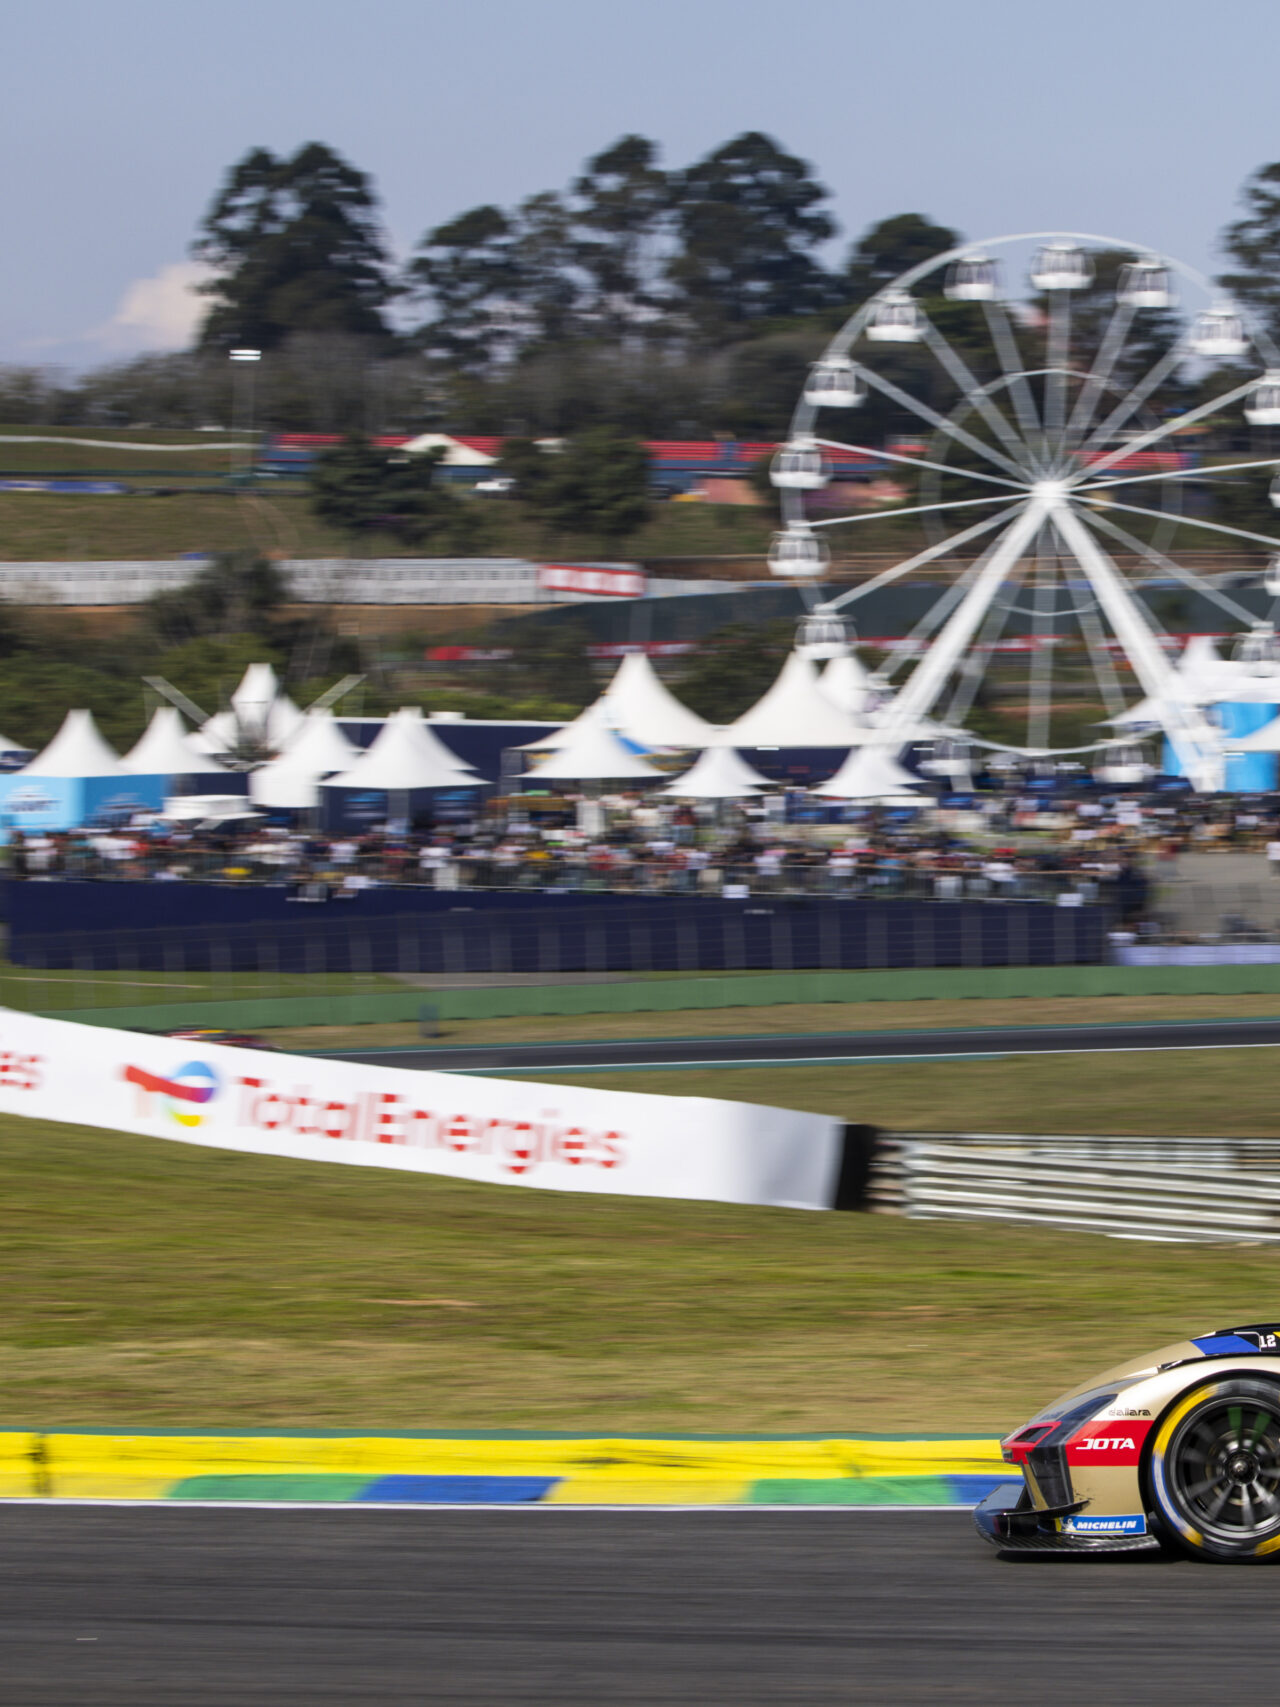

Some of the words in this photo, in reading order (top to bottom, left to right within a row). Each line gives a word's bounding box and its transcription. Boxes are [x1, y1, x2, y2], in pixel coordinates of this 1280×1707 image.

[234, 1075, 628, 1174] TotalEnergies
[1076, 1438, 1136, 1450] JOTA
[1076, 1521, 1137, 1530] MICHELIN
